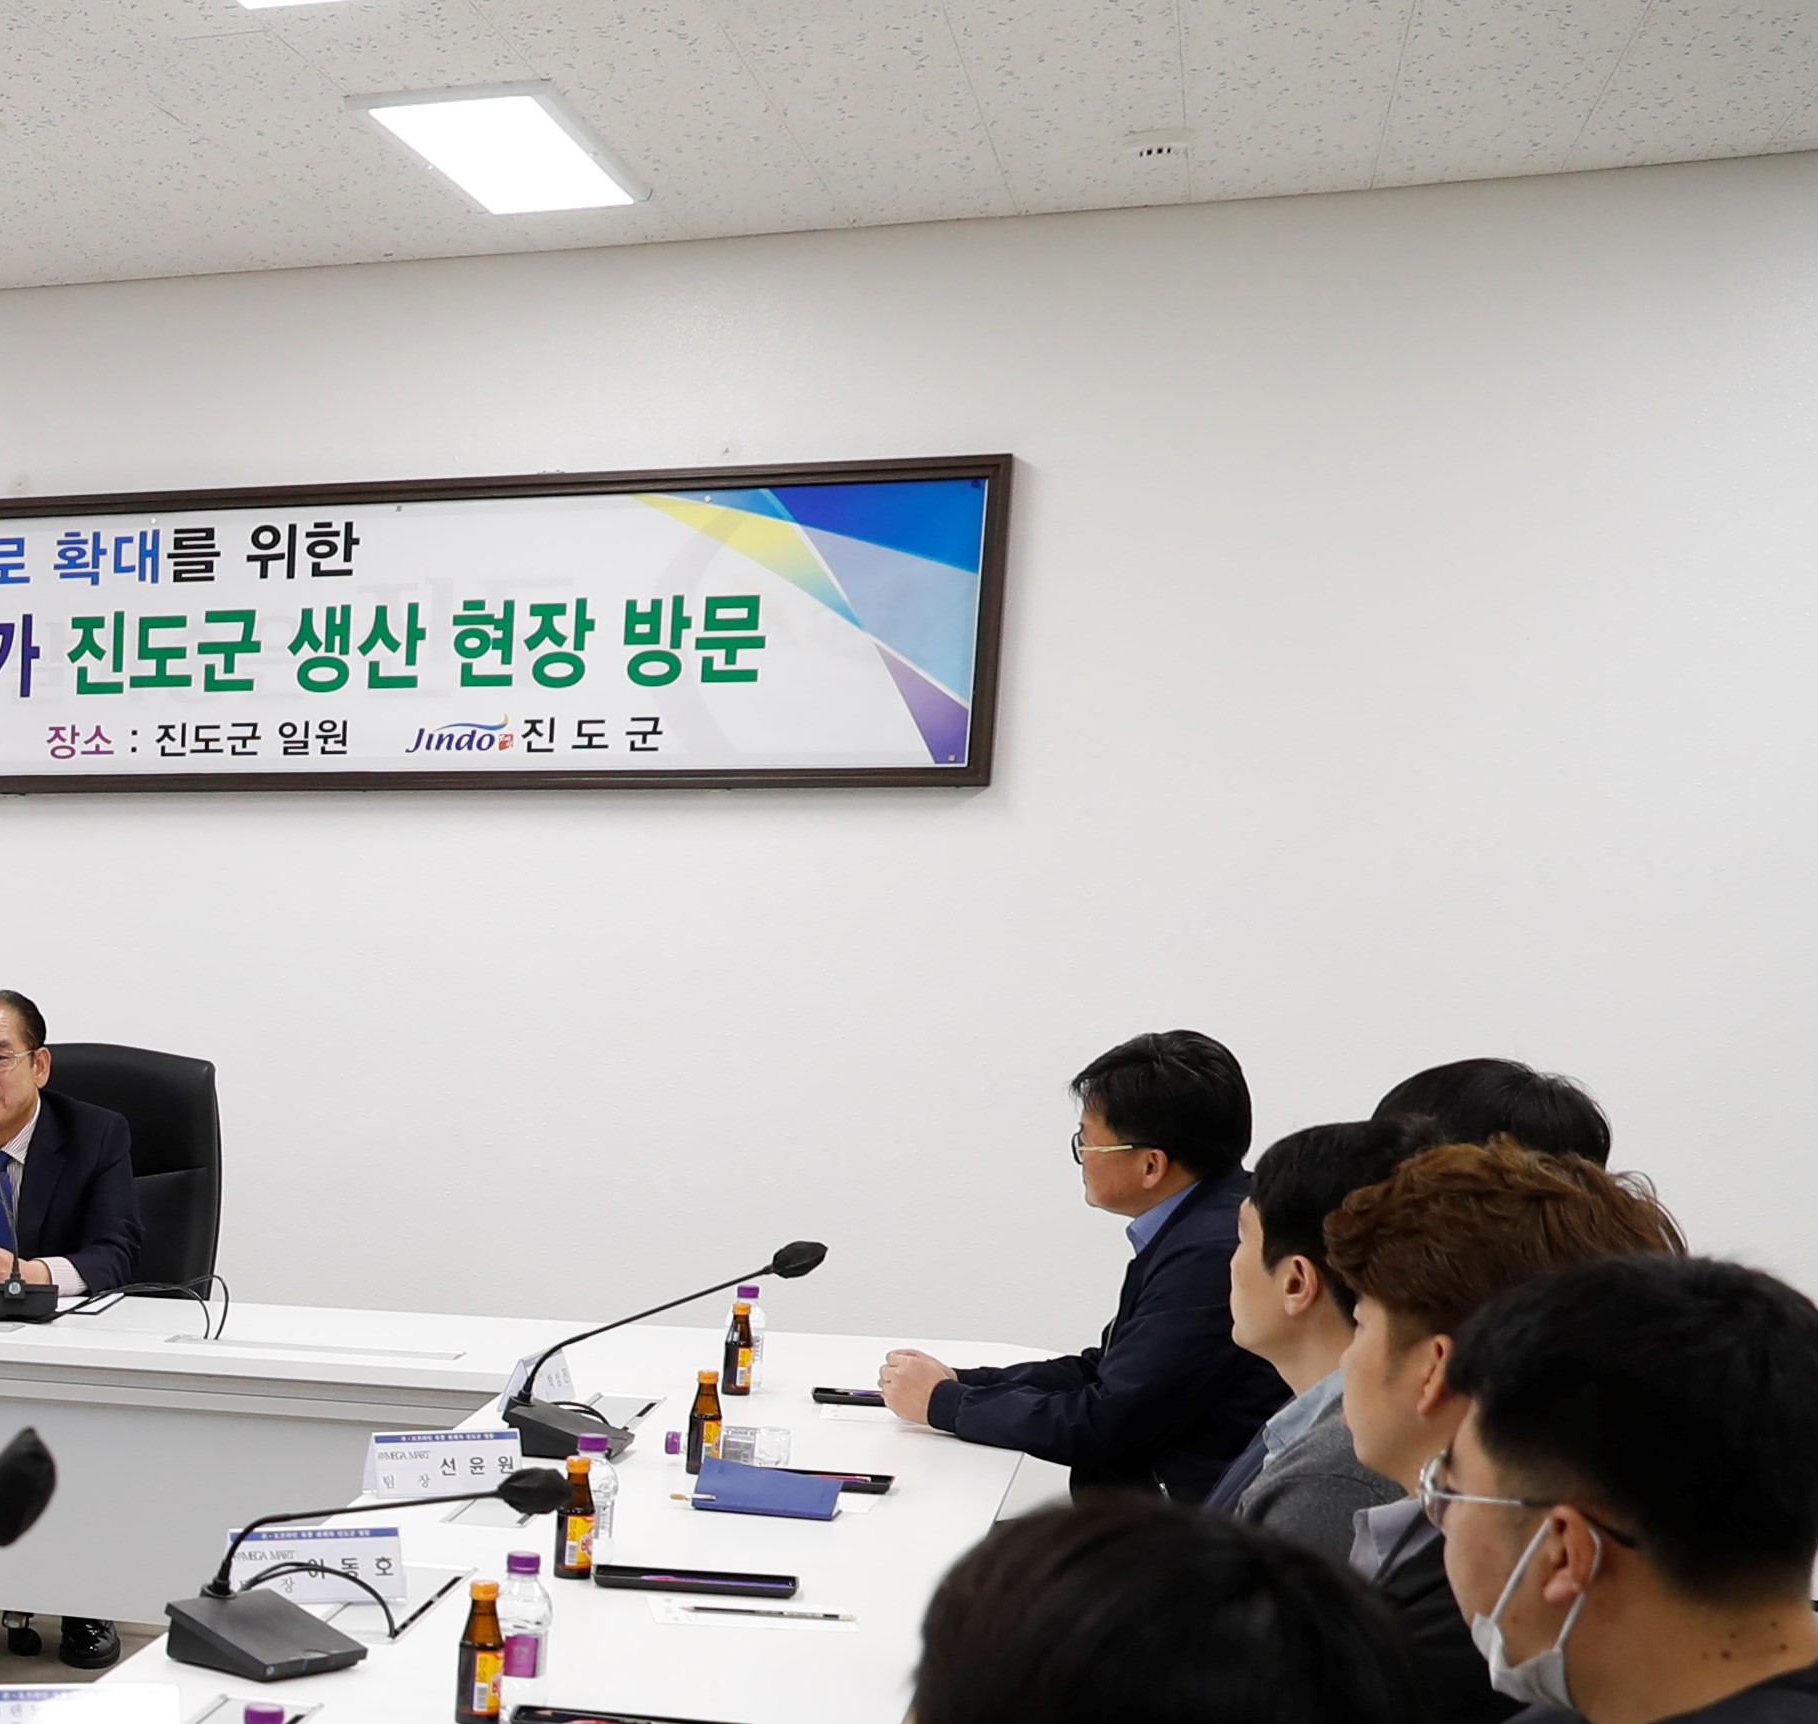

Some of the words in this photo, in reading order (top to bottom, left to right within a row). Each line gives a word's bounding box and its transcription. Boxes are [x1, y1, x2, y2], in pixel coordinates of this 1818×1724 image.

[54, 527, 221, 586] 확대를
[246, 521, 360, 579] 위한
[67, 609, 261, 695] 진도군
[287, 602, 426, 693] 생산
[452, 598, 595, 689] 현장
[623, 595, 766, 687] 방문
[46, 724, 114, 759] 장소
[155, 722, 261, 757] 진도군
[278, 720, 347, 756] 일원
[406, 728, 495, 752] Jindo
